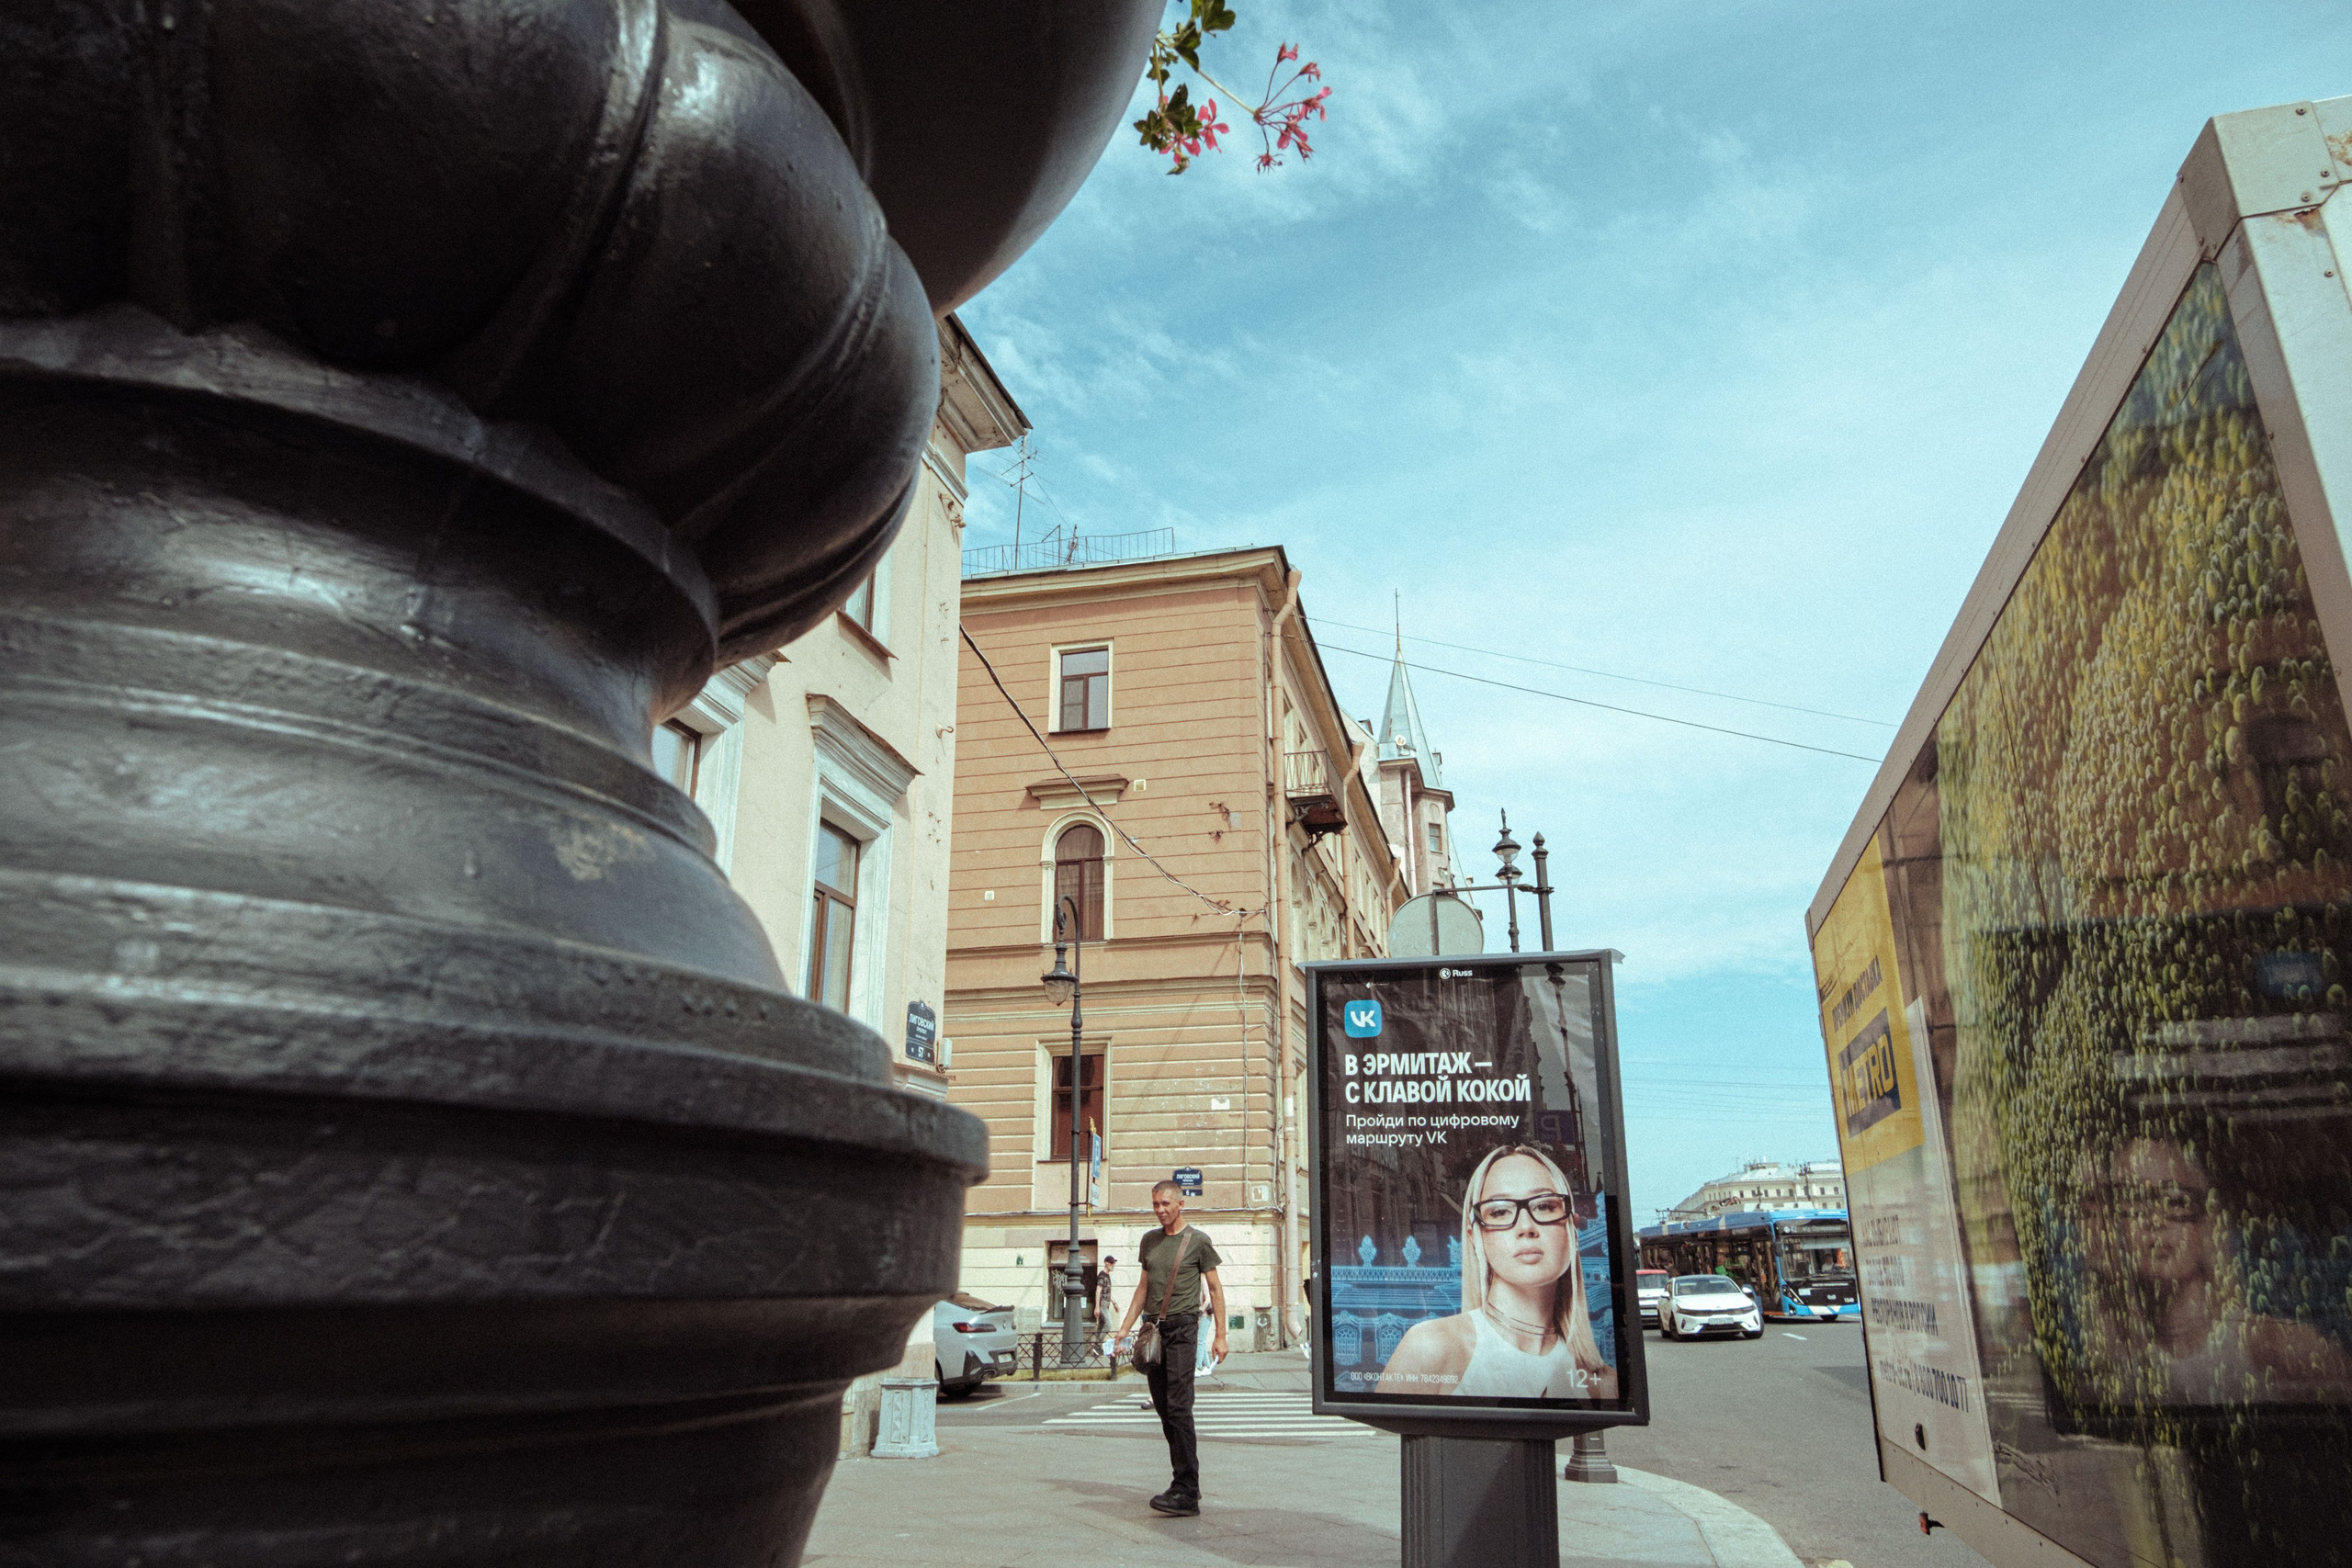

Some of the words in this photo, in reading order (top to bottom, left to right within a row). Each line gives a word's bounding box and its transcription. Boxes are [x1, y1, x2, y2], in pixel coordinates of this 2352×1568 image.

[910, 1013, 934, 1032] ЛИГОВСКИЙ
[1350, 1010, 1376, 1028] VK
[1345, 1054, 1359, 1076] В
[1363, 1052, 1472, 1076] ЭРМИТАЖ
[1842, 1033, 1894, 1118] METRO
[1345, 1081, 1360, 1103] С
[1364, 1075, 1452, 1103] КЛАВОЙ
[1456, 1074, 1532, 1102] КОКОЙ
[1346, 1113, 1404, 1129] Пройди
[1408, 1116, 1427, 1127] по
[1430, 1113, 1519, 1129] цифровому
[1346, 1132, 1423, 1147] маршруту
[1426, 1131, 1448, 1144] VK
[1566, 1369, 1601, 1388] 12+
[1931, 1368, 1948, 1405] 700
[1947, 1372, 1959, 1409] 10
[1956, 1375, 1969, 1413] 77
